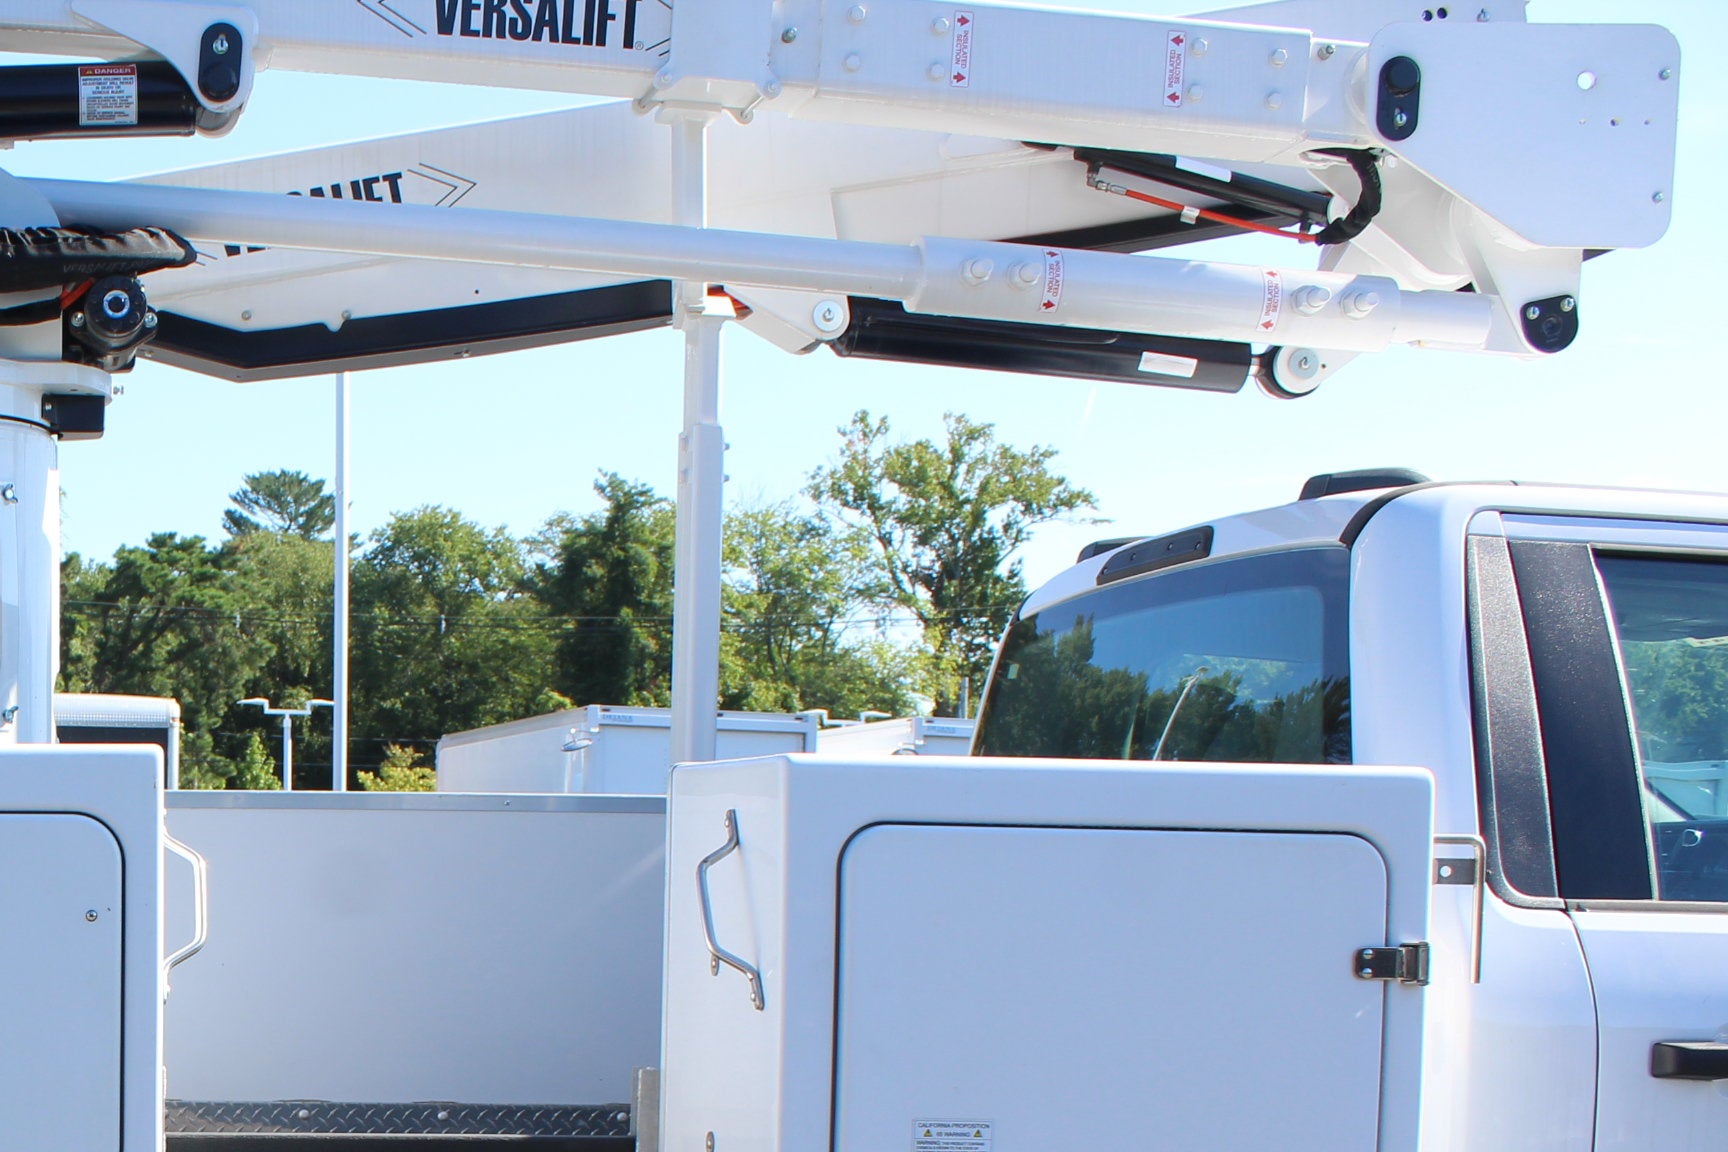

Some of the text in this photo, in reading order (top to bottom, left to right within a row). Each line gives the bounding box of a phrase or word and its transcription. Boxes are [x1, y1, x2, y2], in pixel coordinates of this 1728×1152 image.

[436, 0, 641, 49] VERSALIFT
[960, 30, 968, 69] INSULATED
[1168, 50, 1176, 88] INSULATED
[1174, 54, 1182, 84] SECTION
[1052, 260, 1060, 298] INSULATED
[1264, 280, 1273, 316] INSULATED
[1272, 283, 1280, 312] SECTION
